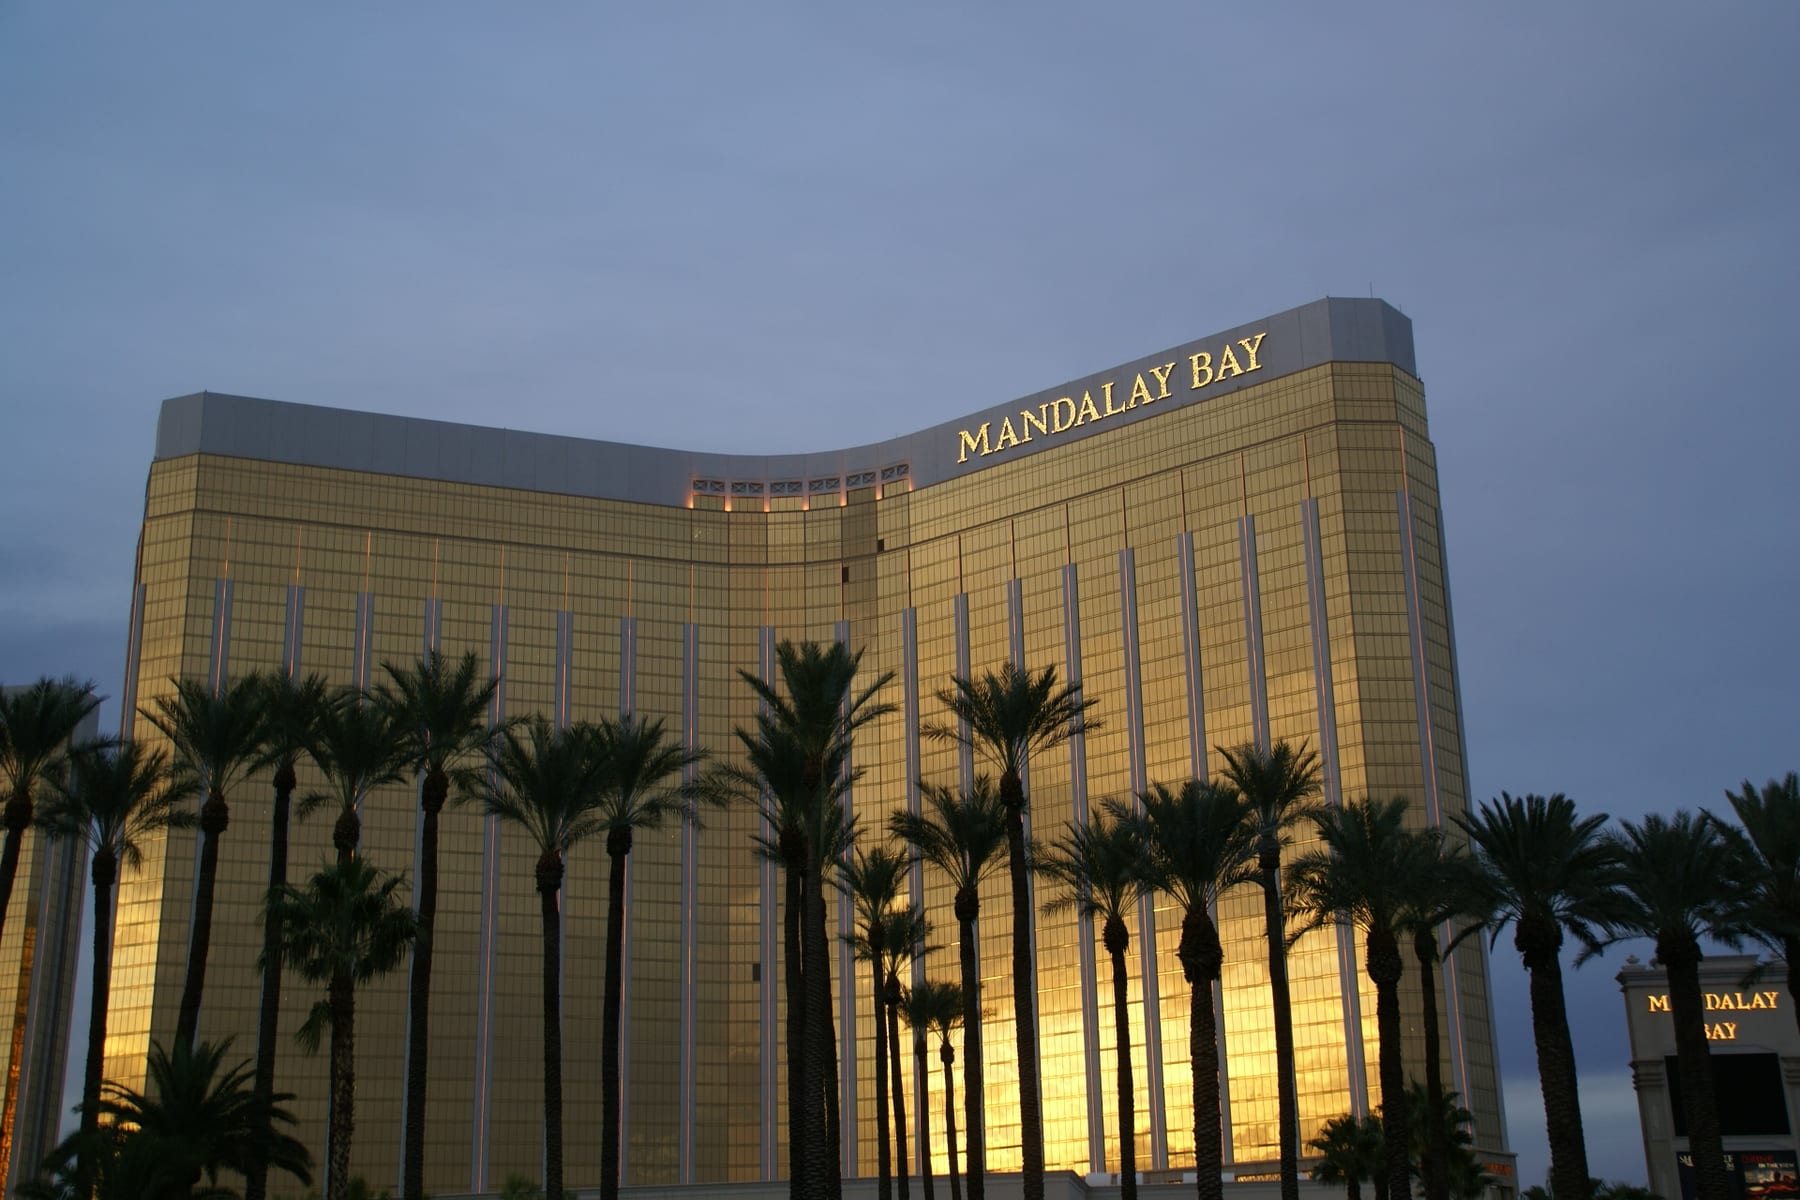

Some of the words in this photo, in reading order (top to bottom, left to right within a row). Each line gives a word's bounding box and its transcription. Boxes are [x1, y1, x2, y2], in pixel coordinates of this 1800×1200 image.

[957, 362, 1176, 464] MANDALAY
[1189, 333, 1267, 390] BAY
[1648, 991, 1779, 1012] MDALAY
